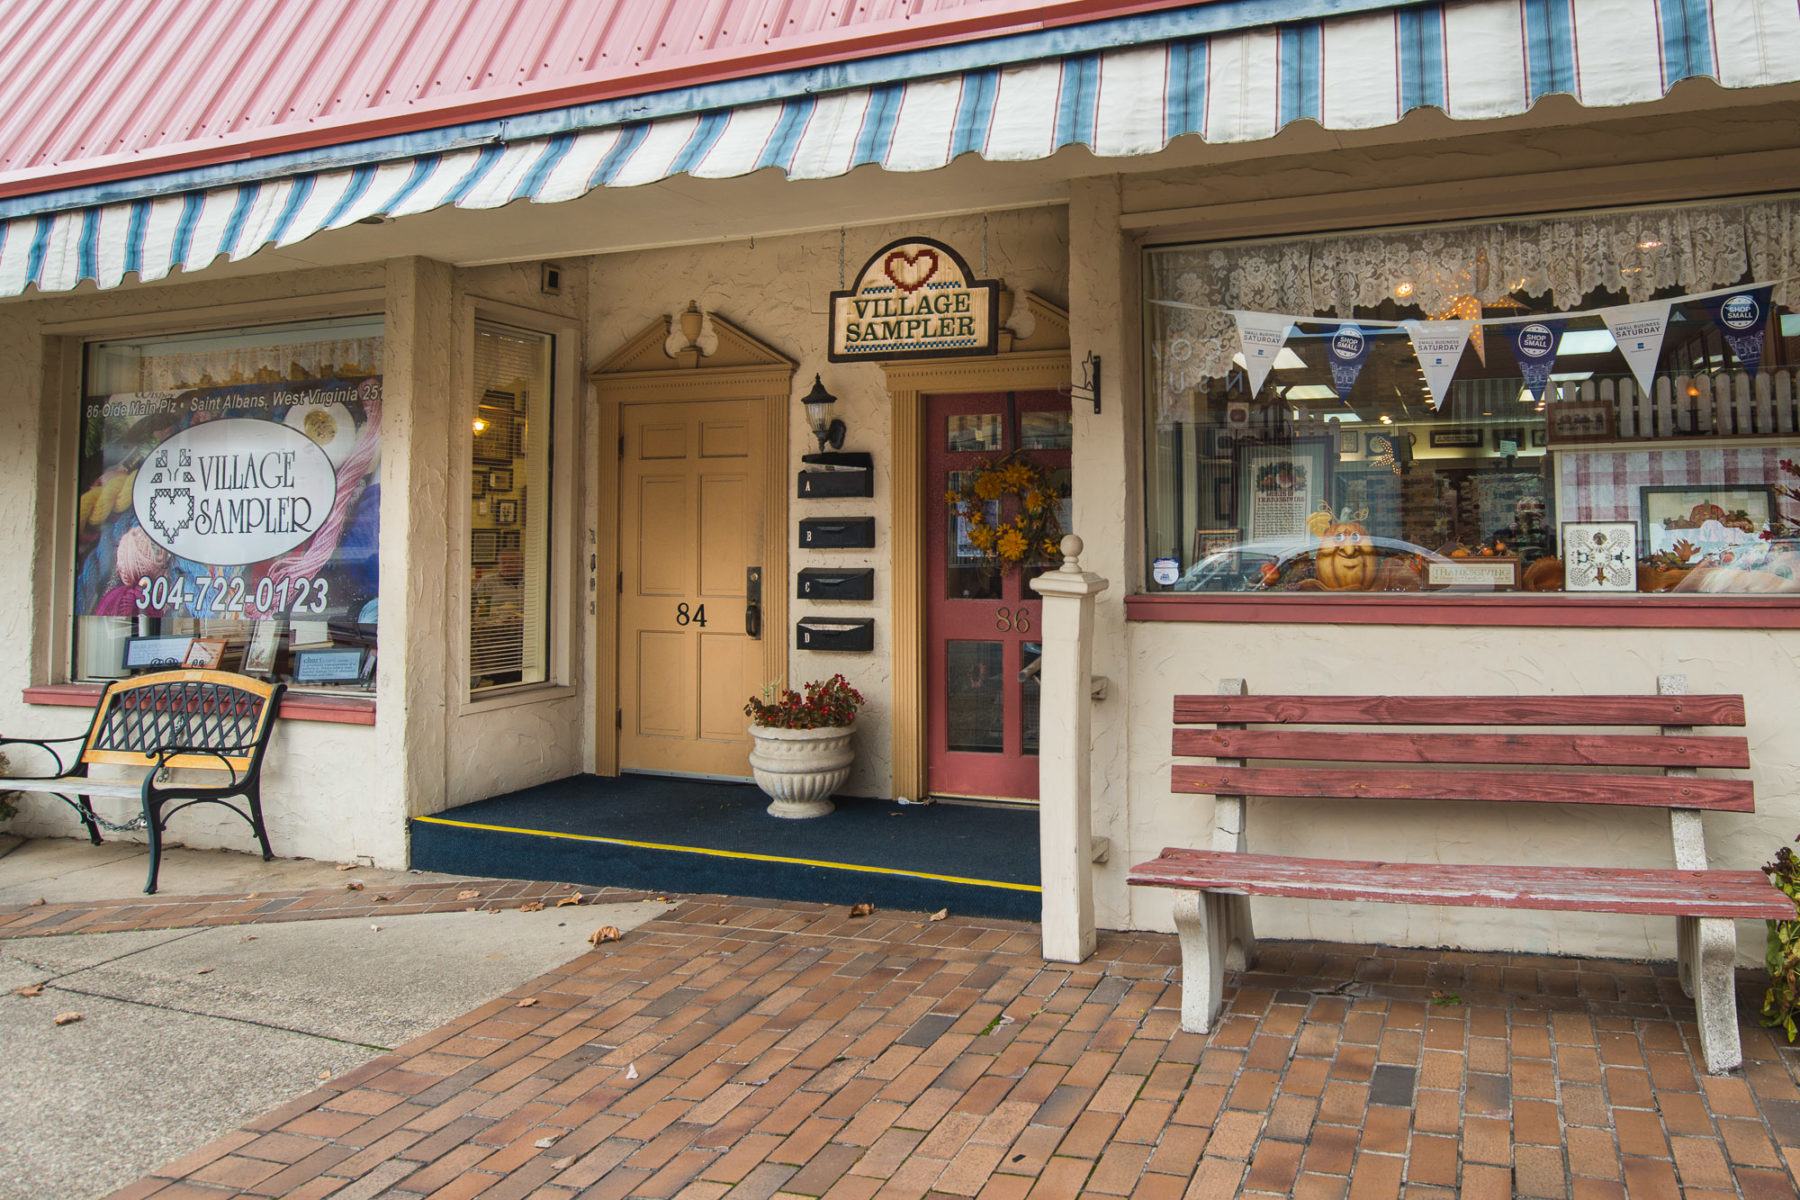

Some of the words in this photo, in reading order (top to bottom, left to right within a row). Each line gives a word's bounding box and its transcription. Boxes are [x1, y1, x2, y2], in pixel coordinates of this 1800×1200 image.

[853, 293, 970, 319] VILLAGE
[846, 317, 976, 343] SAMPLER
[1243, 334, 1281, 344] SATURDAY
[1616, 326, 1661, 338] SATURDAY
[1337, 341, 1358, 352] SMALL
[1340, 336, 1358, 344] SHOP
[1524, 340, 1547, 348] SMALL
[86, 405, 99, 418] 86
[102, 402, 126, 417] Olde
[128, 400, 156, 415] Main
[159, 400, 176, 413] Plz
[190, 397, 220, 412] Saint
[273, 391, 305, 406] West
[309, 386, 358, 407] Virginia
[197, 450, 296, 492] VILLAGE
[805, 480, 811, 492] A
[195, 496, 313, 535] SAMPLER
[806, 530, 812, 542] B
[135, 576, 329, 614] 304-722-0123
[676, 602, 708, 627] 84
[994, 606, 1030, 634] 86
[805, 633, 810, 643] D
